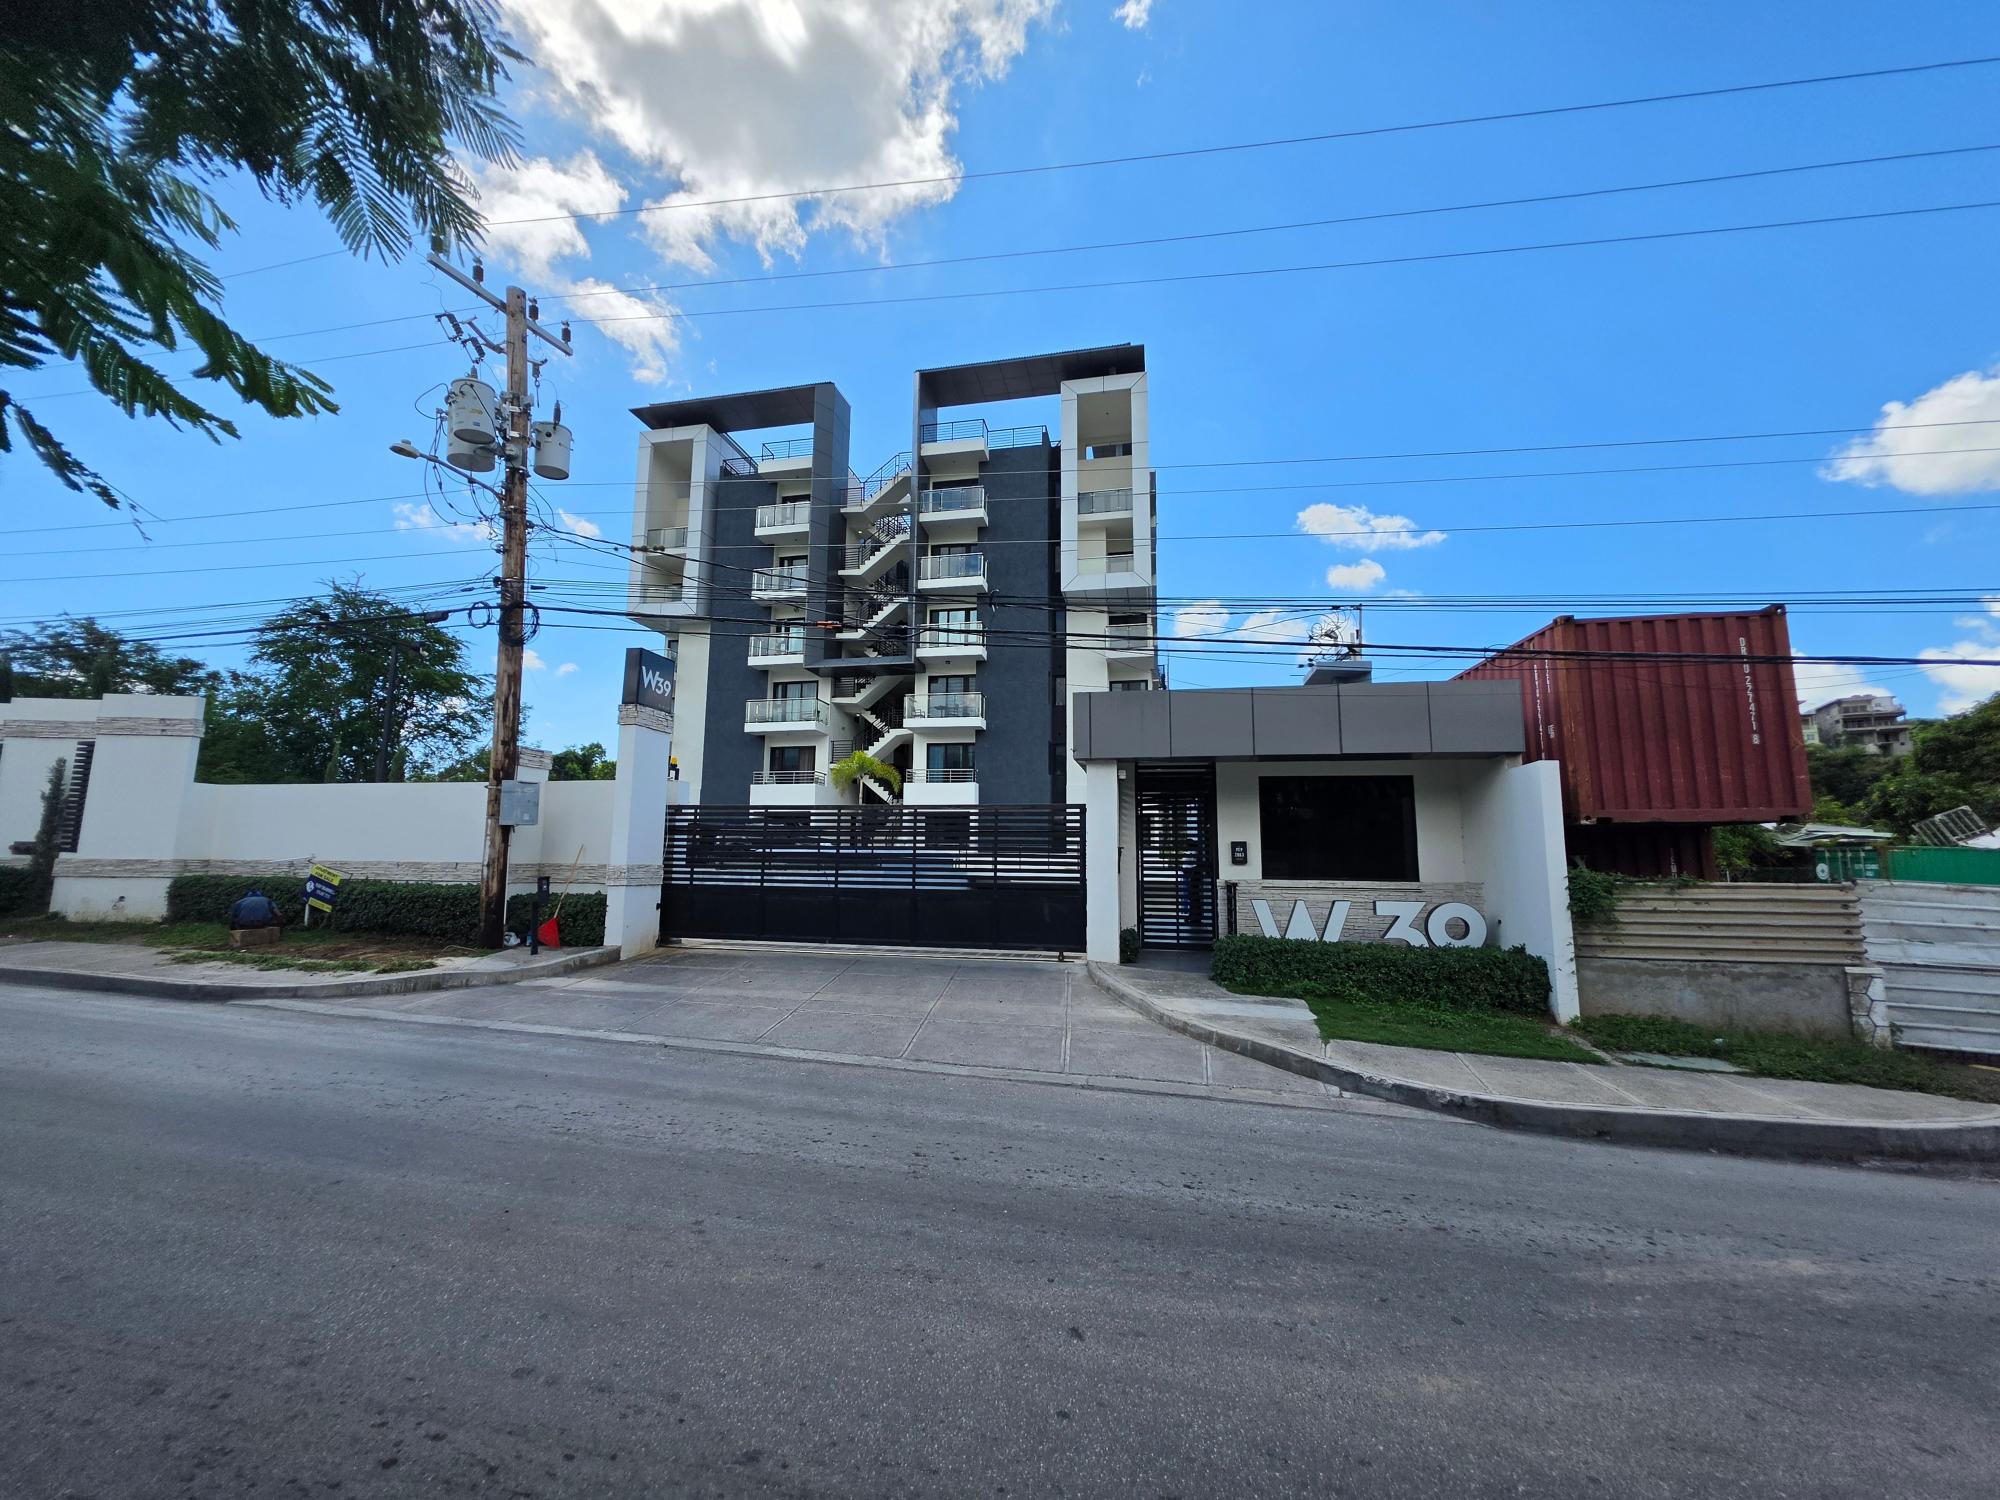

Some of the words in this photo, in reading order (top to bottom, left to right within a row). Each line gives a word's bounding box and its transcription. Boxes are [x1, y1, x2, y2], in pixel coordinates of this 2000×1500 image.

[1739, 637, 1750, 674] DRU
[642, 666, 671, 696] W39
[1250, 899, 1352, 942] W
